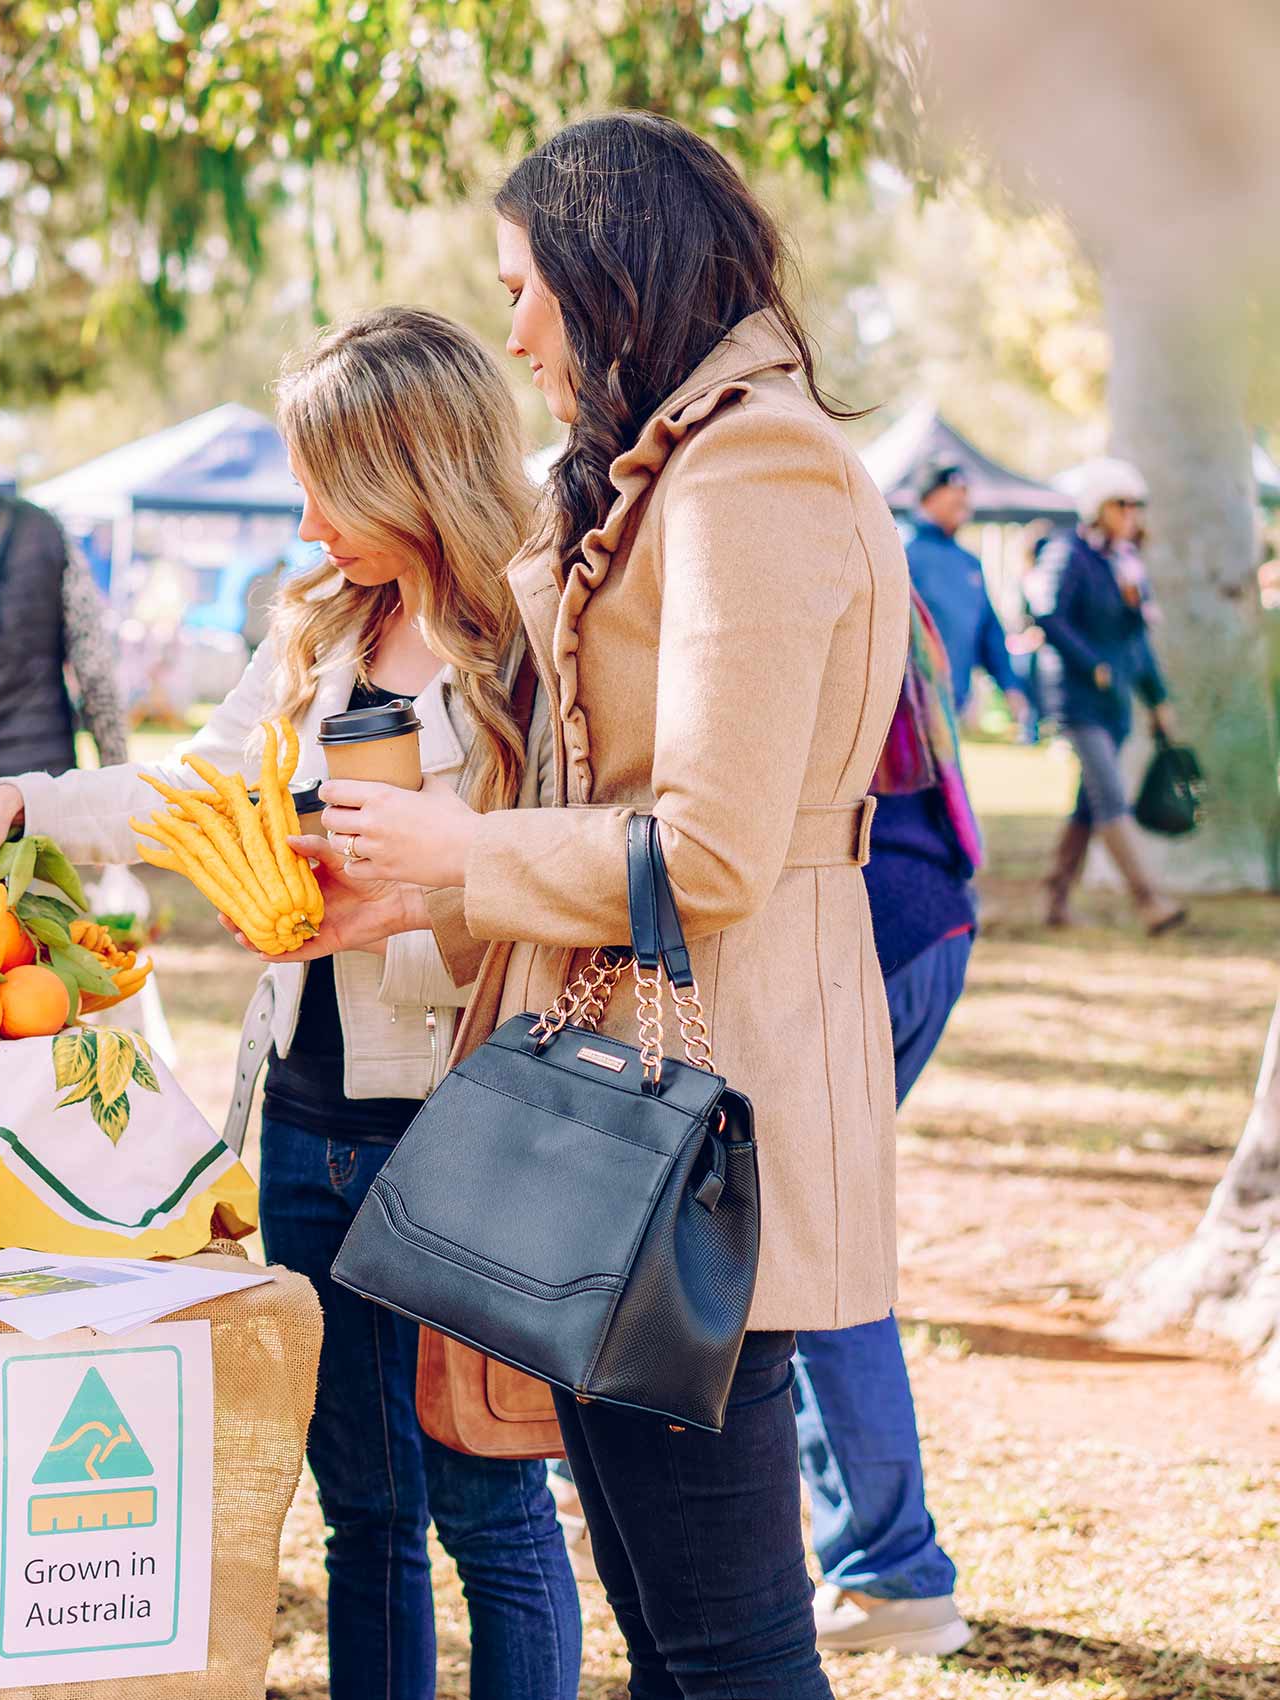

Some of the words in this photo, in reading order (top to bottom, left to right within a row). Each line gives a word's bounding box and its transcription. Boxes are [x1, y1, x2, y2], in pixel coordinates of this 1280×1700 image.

[24, 1558, 120, 1585] Grown
[131, 1551, 156, 1576] in
[25, 1593, 151, 1628] Australia
